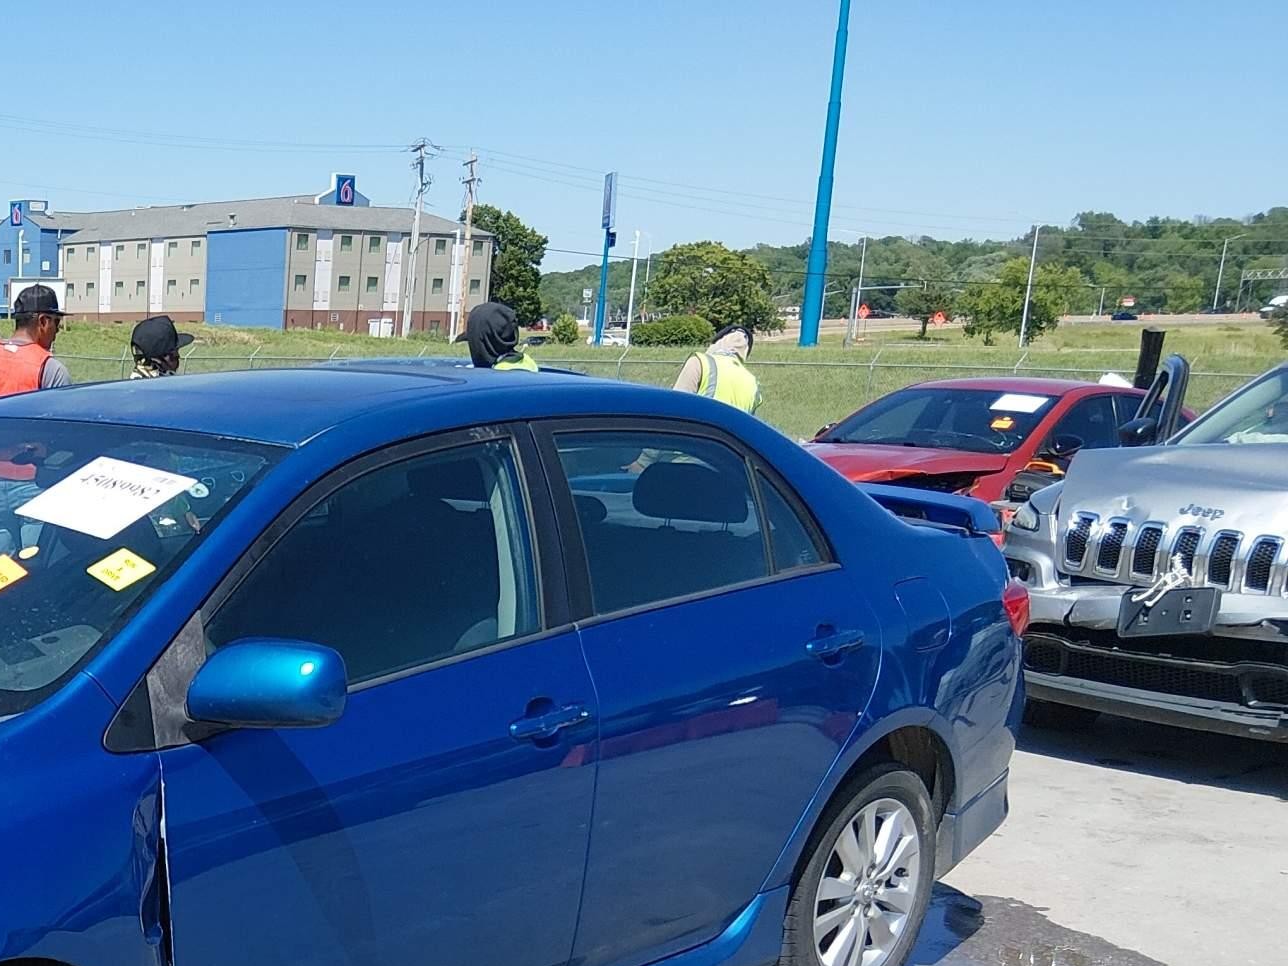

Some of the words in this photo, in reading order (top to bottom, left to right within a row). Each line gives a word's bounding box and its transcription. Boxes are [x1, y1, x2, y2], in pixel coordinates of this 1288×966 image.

[340, 179, 352, 202] 6
[12, 204, 21, 224] 6
[1179, 503, 1225, 521] Jeep
